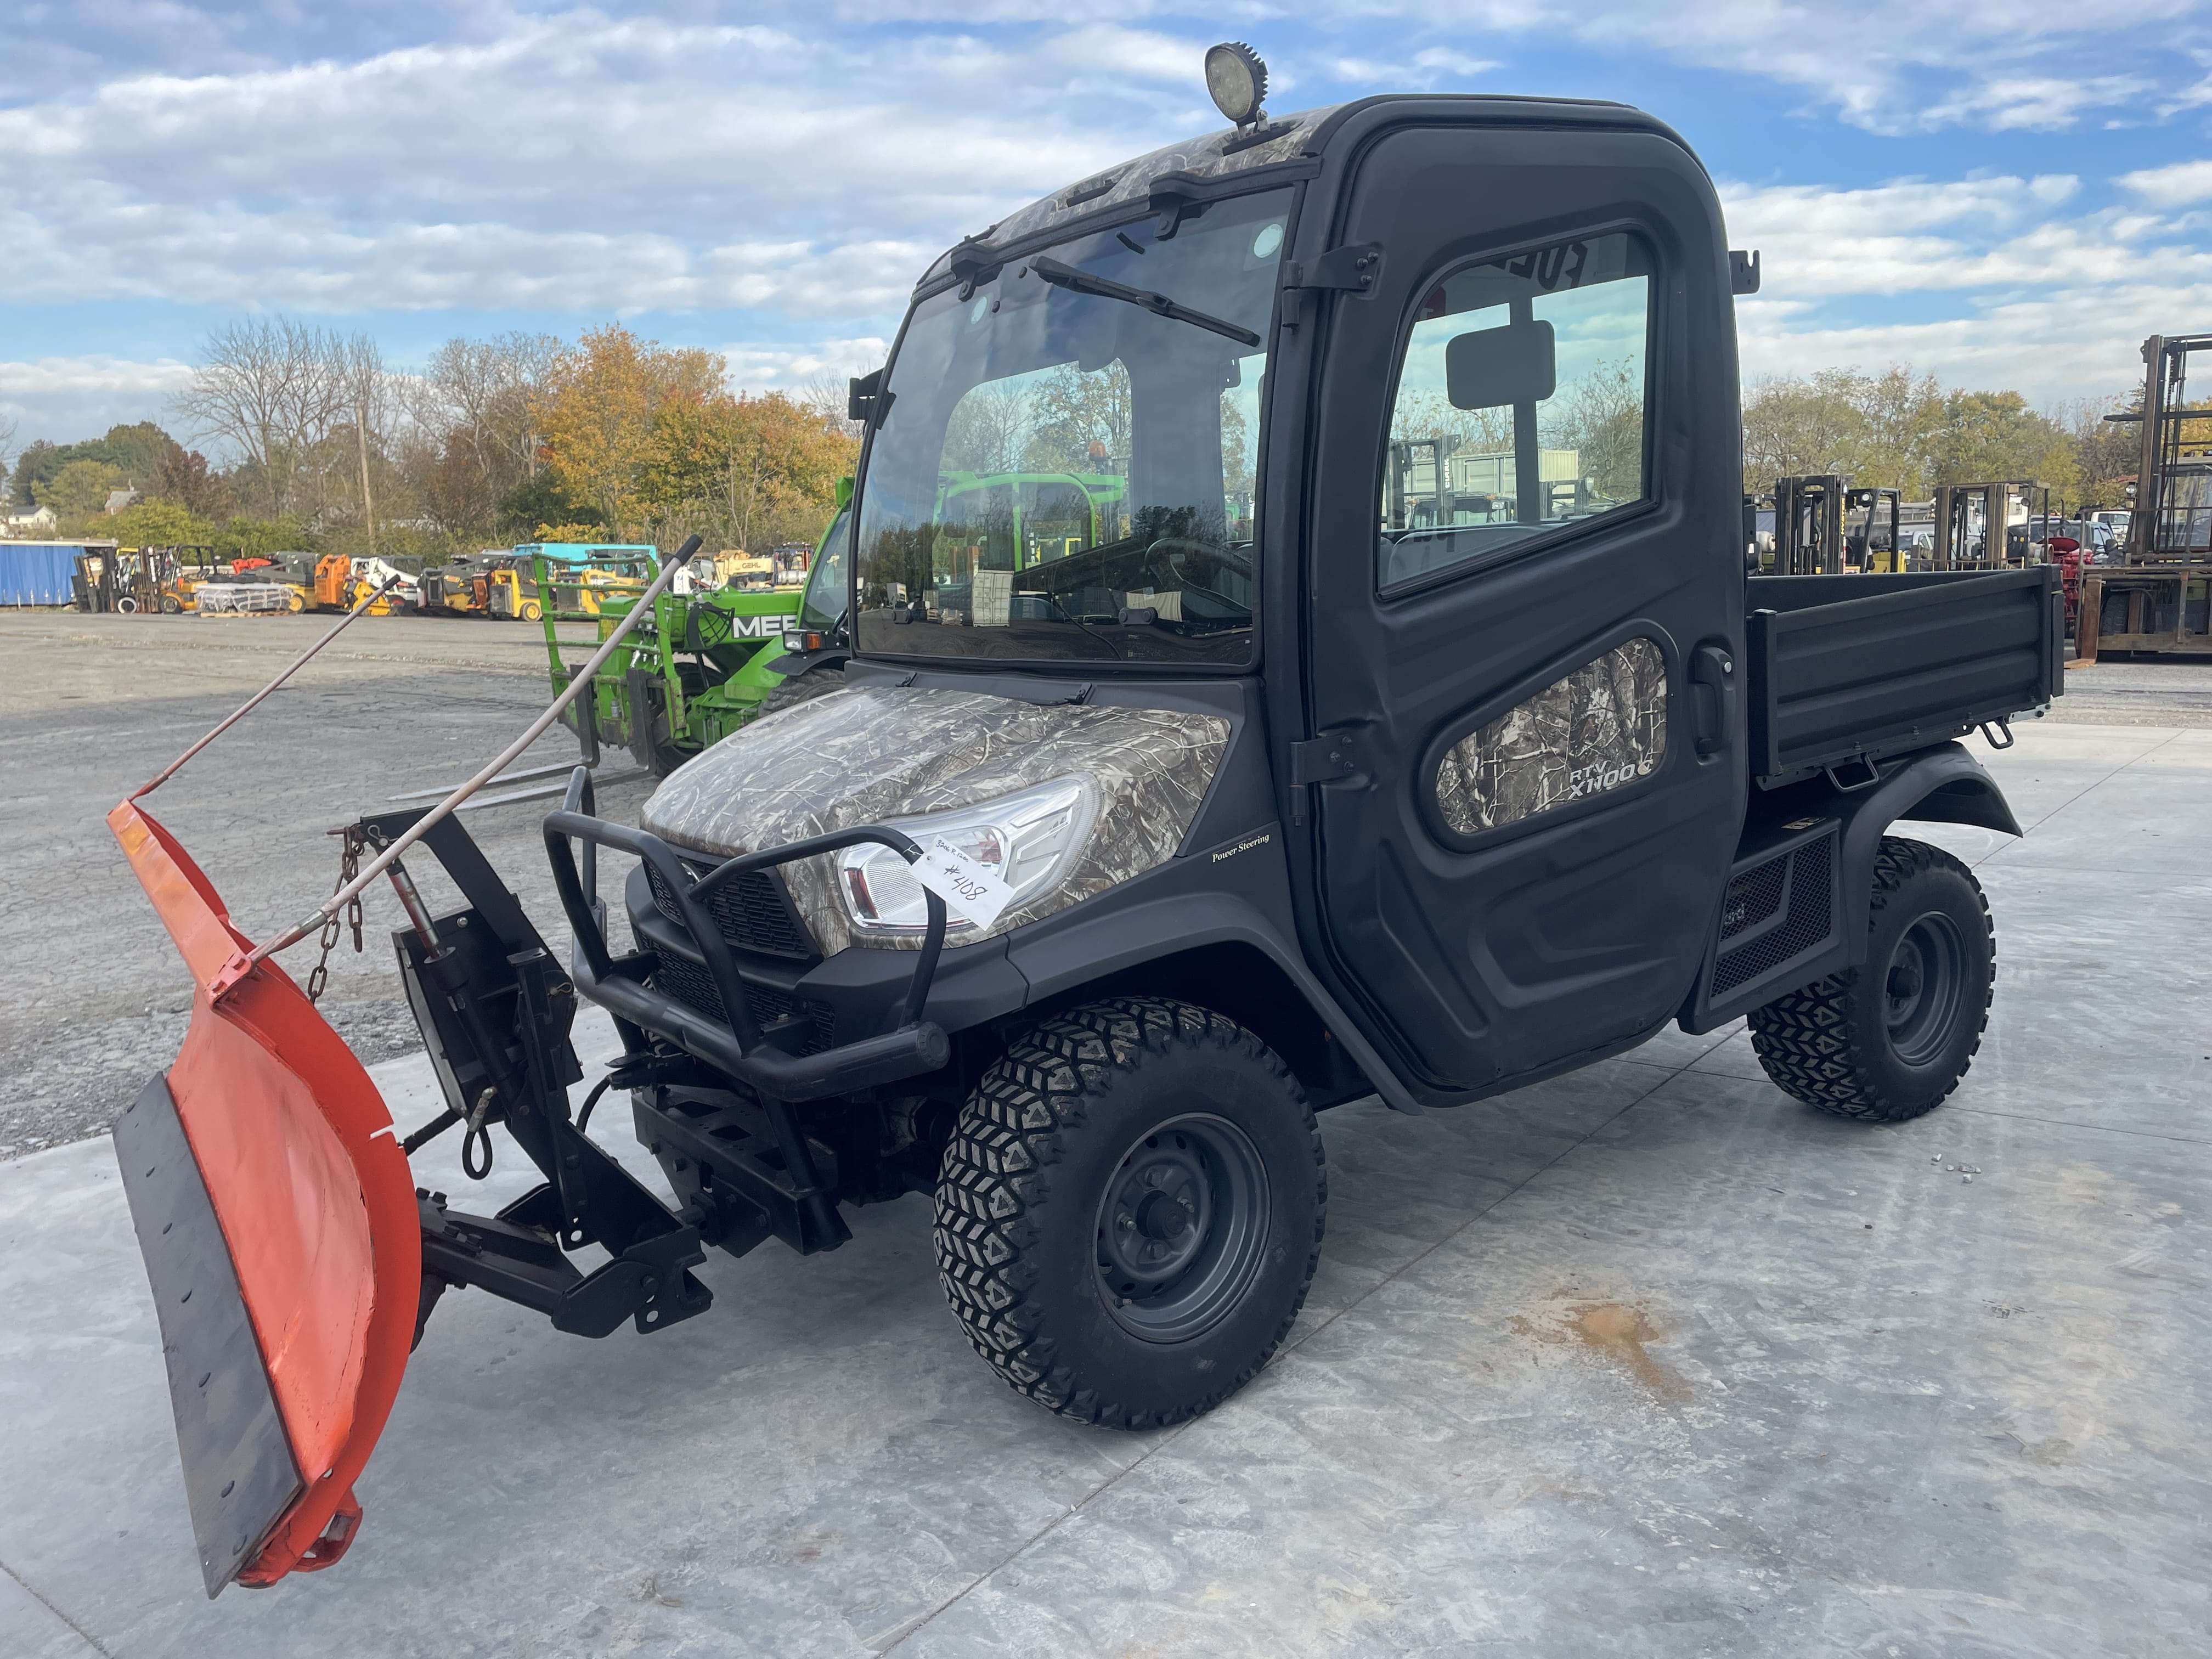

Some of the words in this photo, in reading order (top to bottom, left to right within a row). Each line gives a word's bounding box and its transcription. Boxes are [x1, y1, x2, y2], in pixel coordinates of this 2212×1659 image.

[1570, 760, 1611, 783] RTV
[1212, 847, 1238, 863] Power
[1238, 834, 1270, 853] Steering
